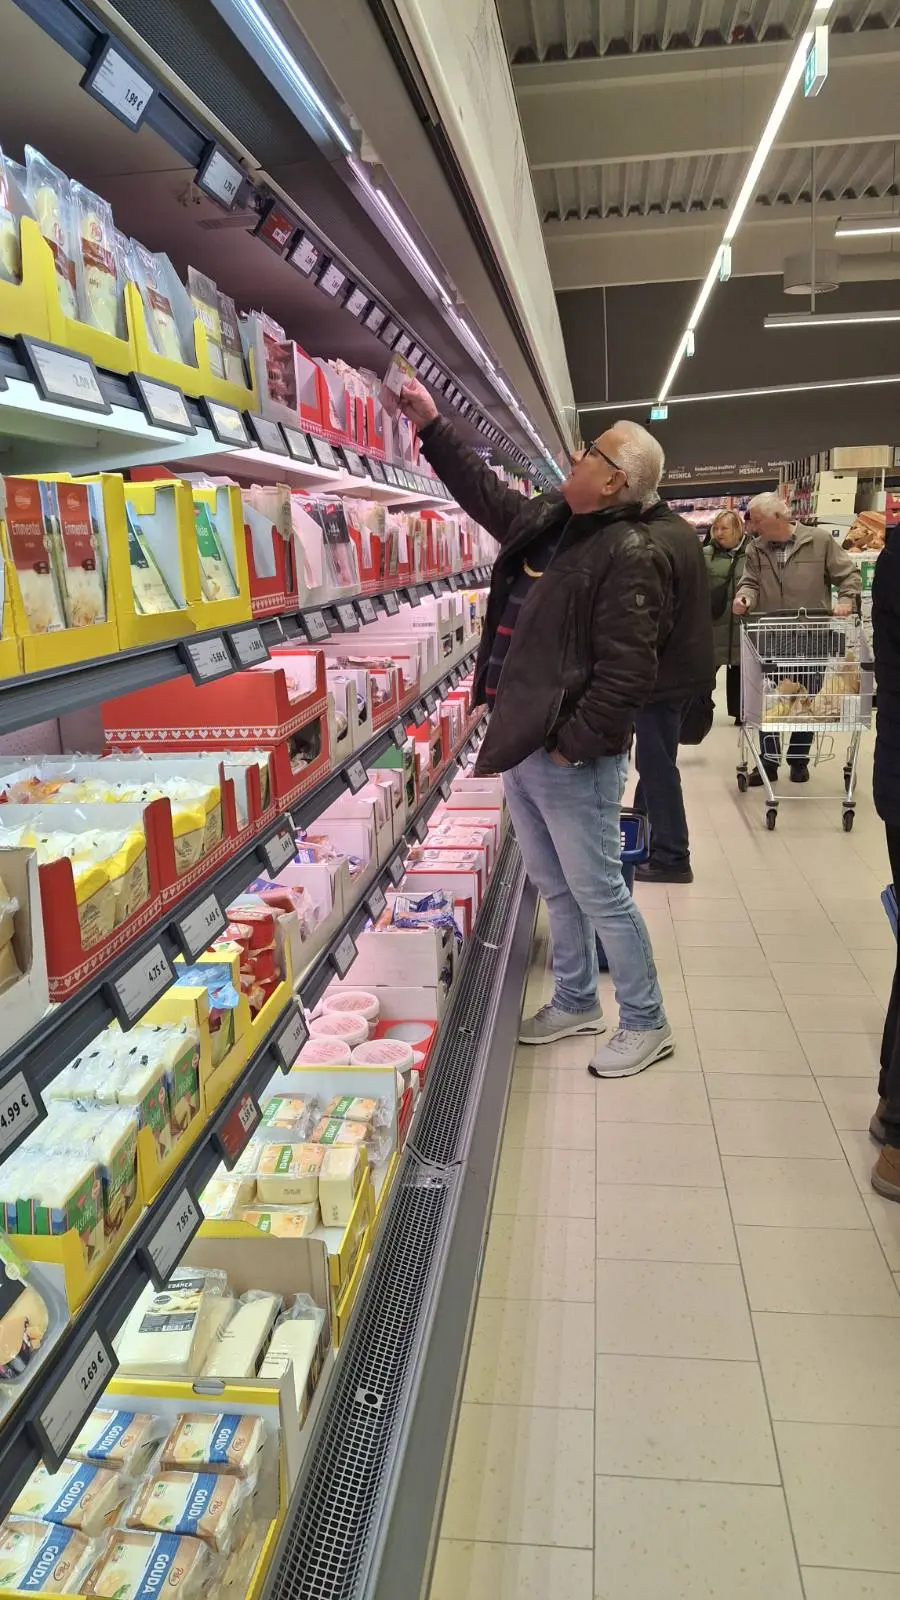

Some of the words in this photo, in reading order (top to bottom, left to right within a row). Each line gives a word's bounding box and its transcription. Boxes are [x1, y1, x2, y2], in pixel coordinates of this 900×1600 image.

[125, 89, 138, 106] 1.99
[136, 100, 143, 111] €
[739, 467, 764, 475] MESNICA
[149, 964, 161, 981] 4.75
[160, 960, 166, 970] €
[0, 1102, 20, 1128] 4.99
[21, 1093, 29, 1107] €
[176, 1211, 188, 1232] 7.95
[187, 1205, 192, 1215] €
[81, 1360, 98, 1390] 2.69
[97, 1351, 104, 1363] €
[98, 1425, 122, 1453] GOUDA
[54, 1480, 85, 1513] GOUDA
[26, 1545, 59, 1585] GOUDA
[143, 1554, 169, 1594] GOUDA
